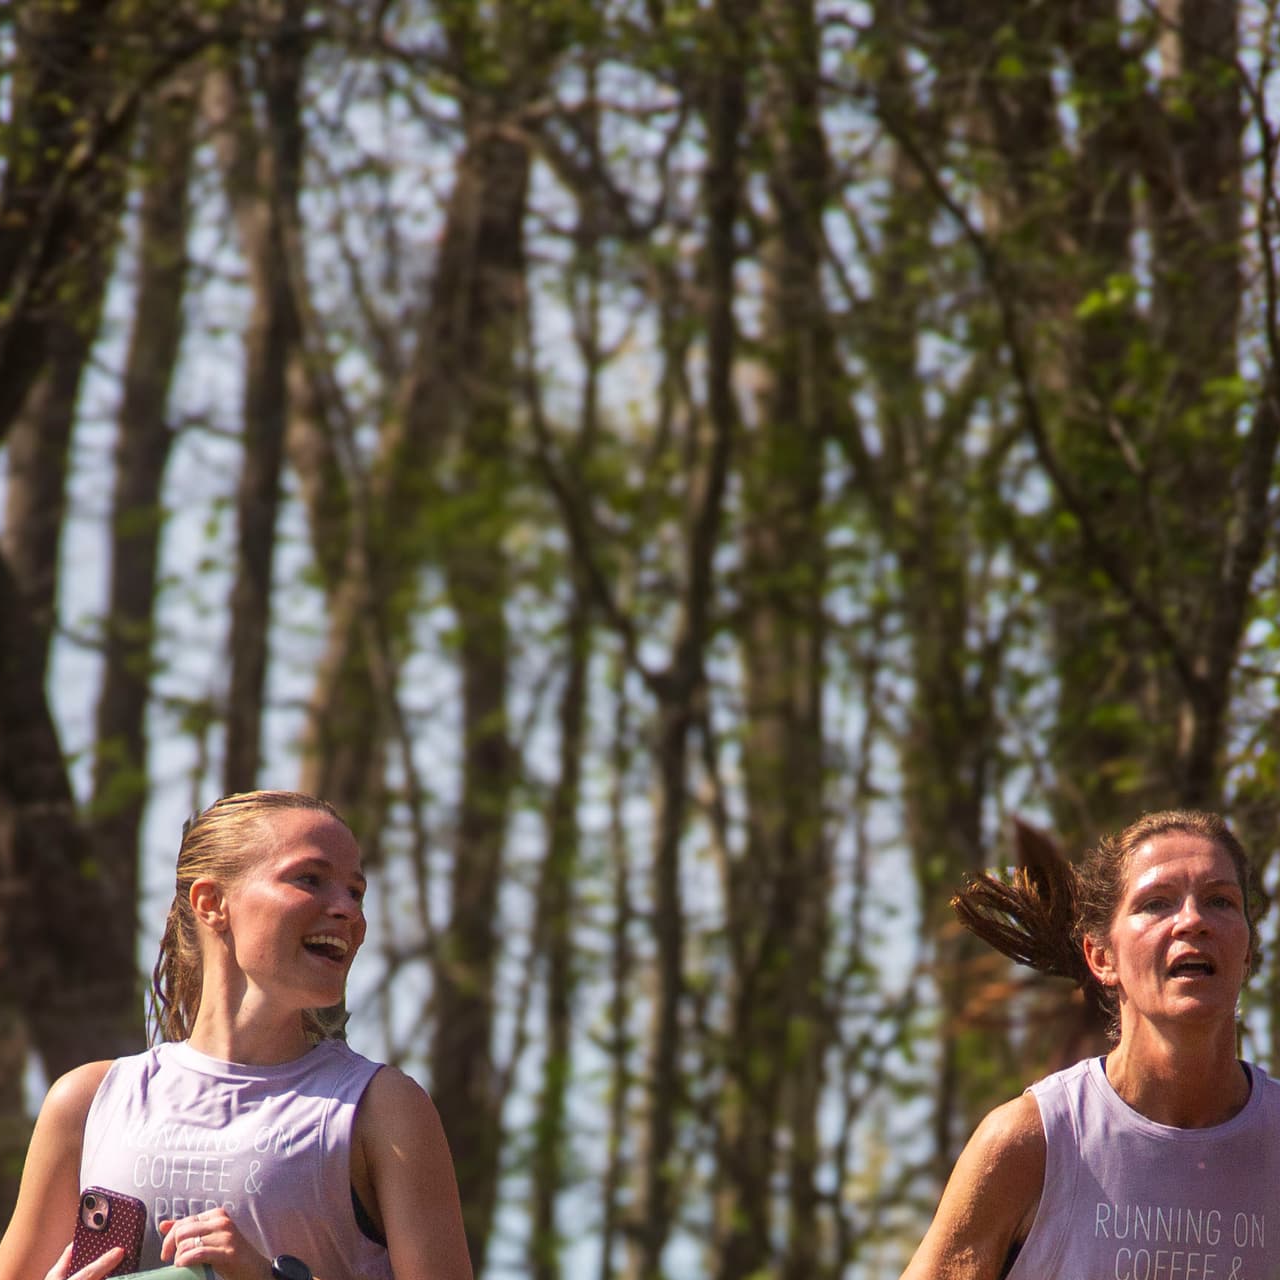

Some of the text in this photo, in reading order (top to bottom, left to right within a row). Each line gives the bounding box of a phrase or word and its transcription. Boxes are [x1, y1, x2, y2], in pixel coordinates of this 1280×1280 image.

[134, 1153, 263, 1196] COFFEE &
[1094, 1202, 1266, 1249] RUNNING ON
